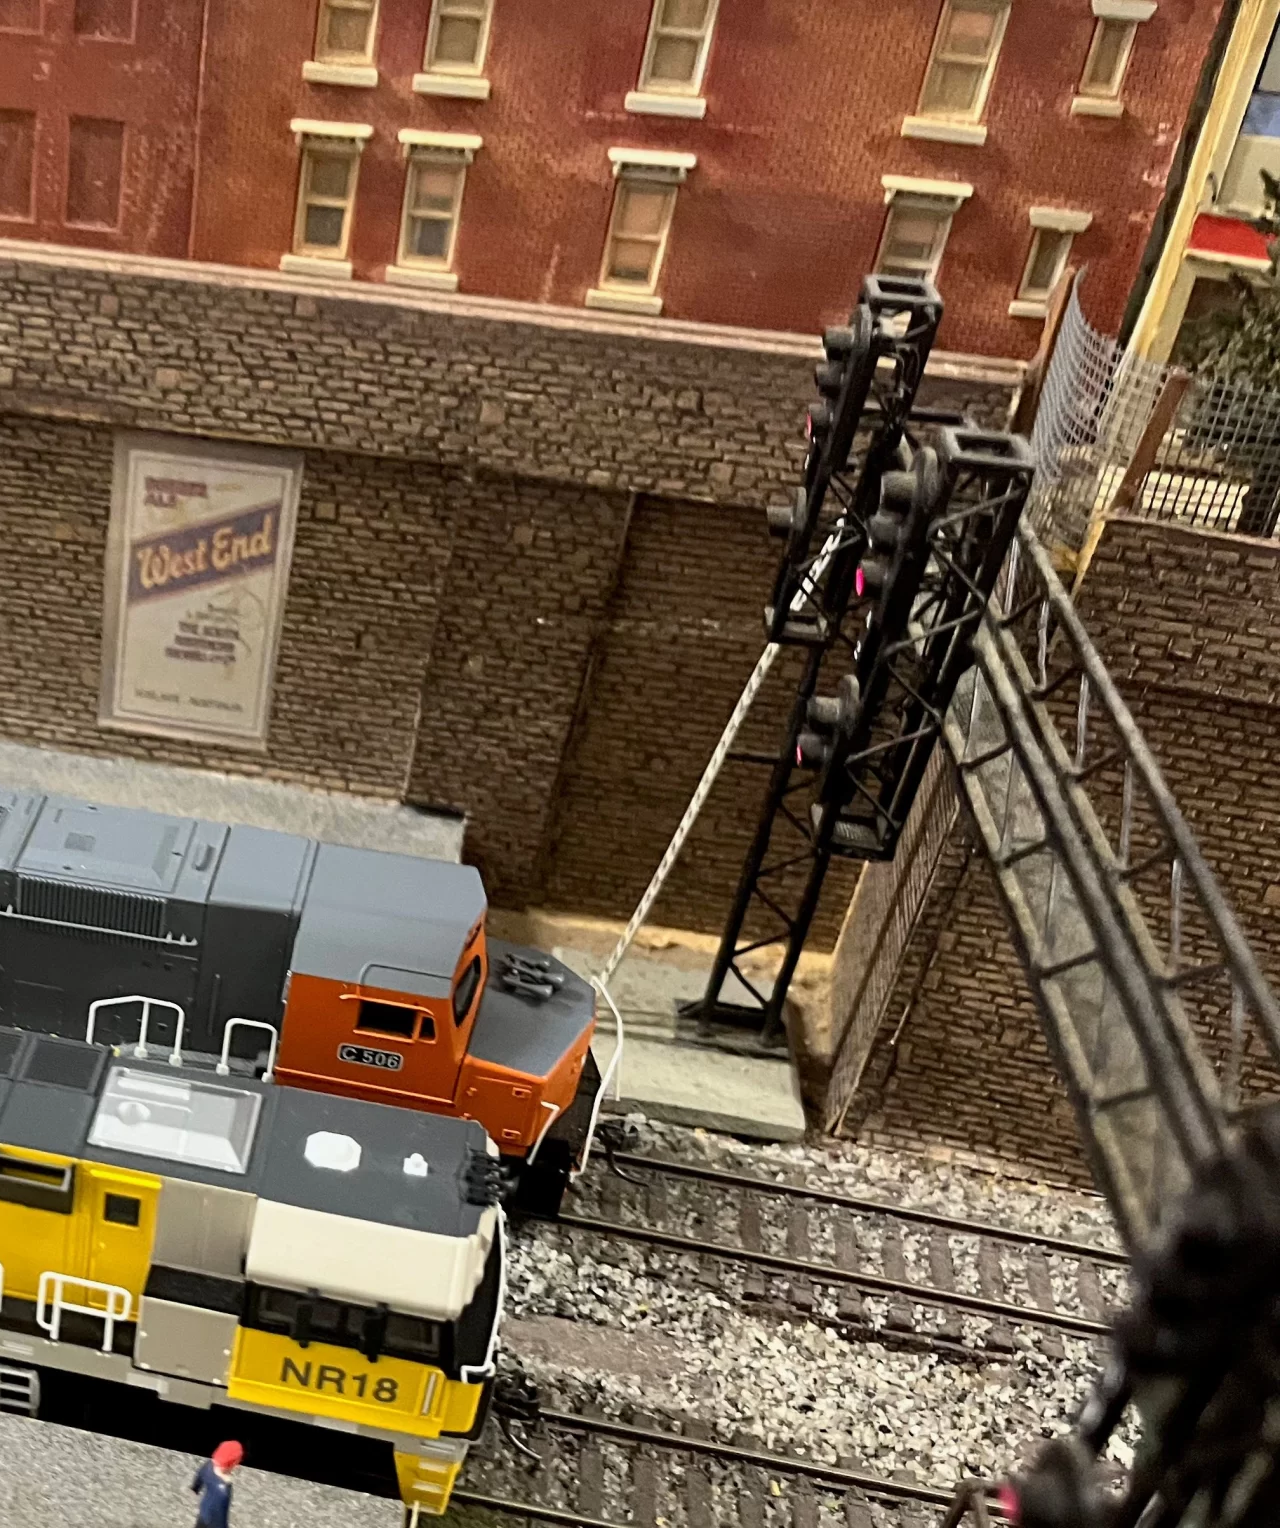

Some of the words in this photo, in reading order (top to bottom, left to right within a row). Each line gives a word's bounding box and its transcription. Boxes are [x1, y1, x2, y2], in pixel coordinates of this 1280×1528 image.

[137, 540, 207, 588] West
[212, 514, 272, 571] End
[341, 1046, 357, 1061] C
[362, 1050, 400, 1068] 506
[279, 1357, 399, 1403] NR18
